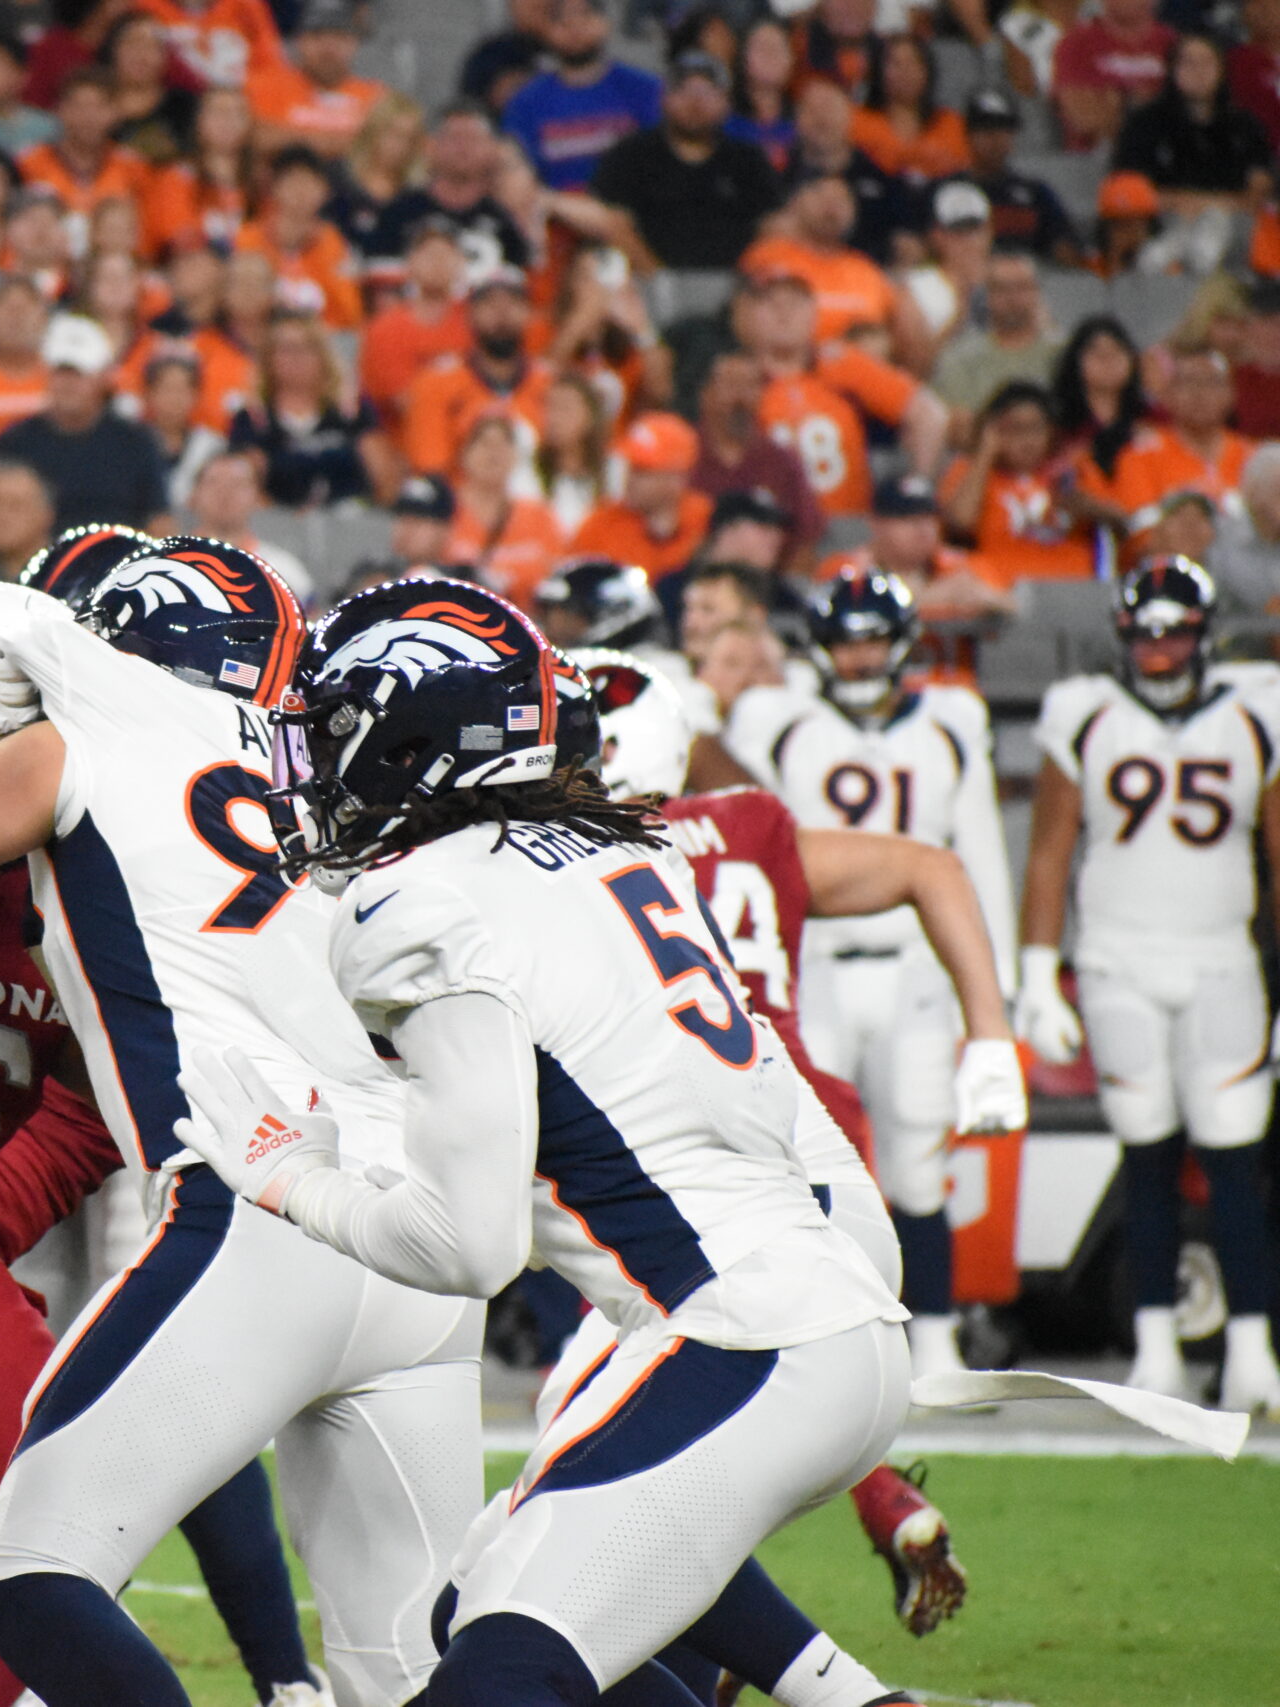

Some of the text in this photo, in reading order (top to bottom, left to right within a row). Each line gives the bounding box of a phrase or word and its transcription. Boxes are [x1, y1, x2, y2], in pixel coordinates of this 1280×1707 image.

[821, 762, 913, 834] 91
[1106, 756, 1235, 848] 95
[601, 863, 757, 1070] 5
[245, 1129, 303, 1165] adidas
